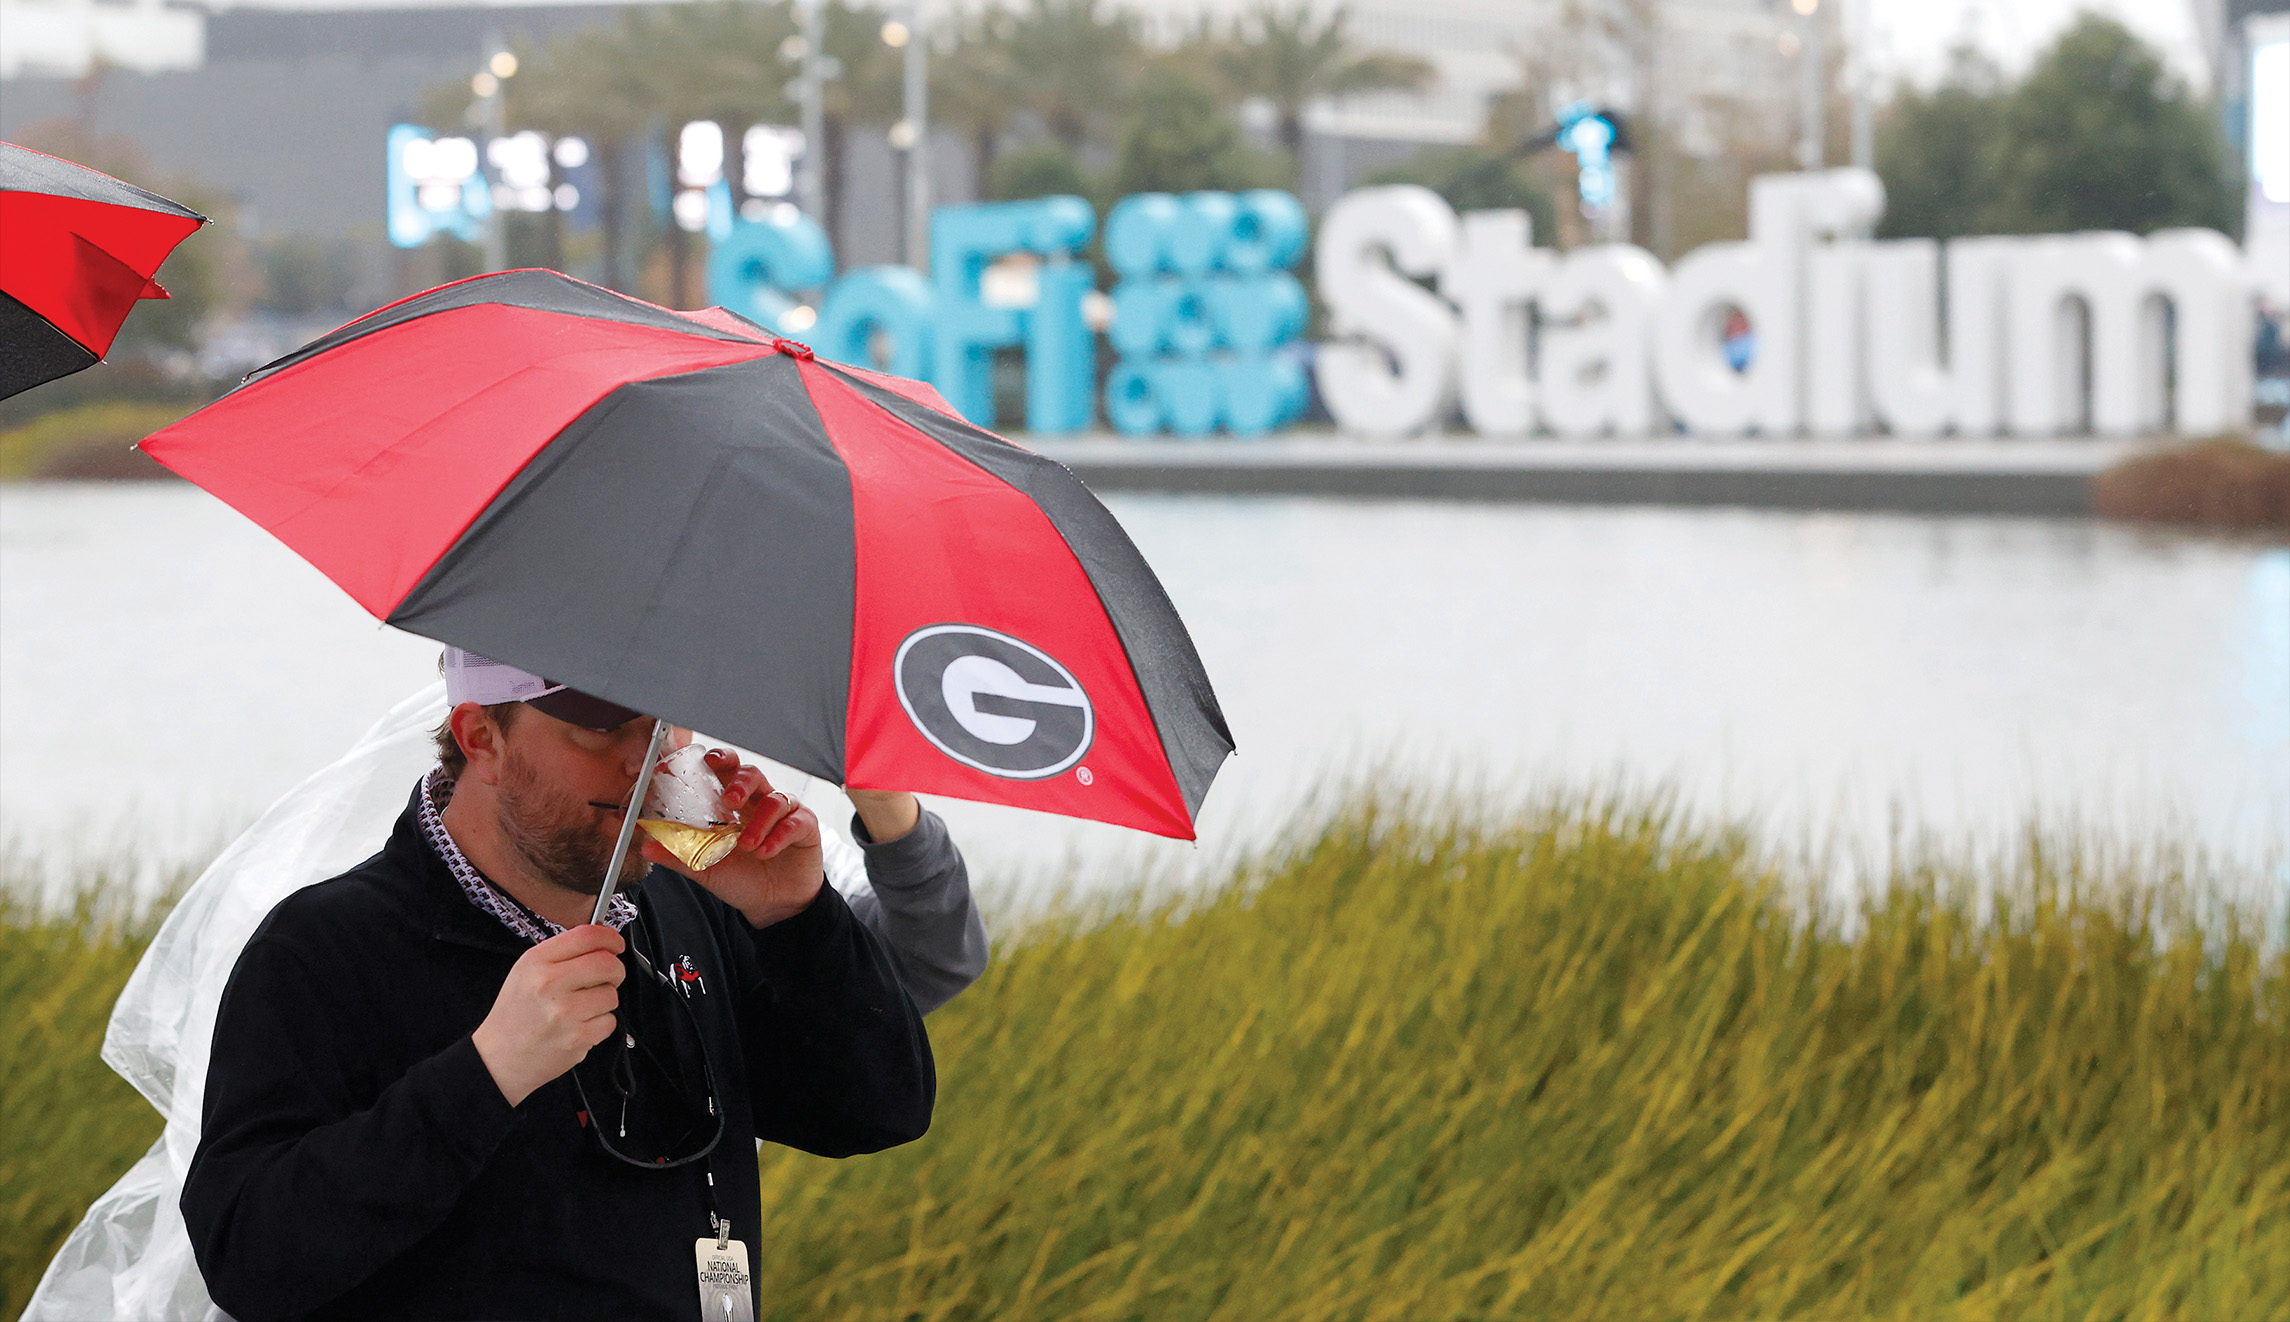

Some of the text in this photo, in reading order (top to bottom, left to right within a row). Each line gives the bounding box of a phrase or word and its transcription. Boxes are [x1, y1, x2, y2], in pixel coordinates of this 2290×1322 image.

[1314, 168, 2250, 438] Stadium
[893, 622, 1096, 782] G
[700, 1271, 749, 1285] CHAMPIONSHIP
[707, 1260, 740, 1273] NATIONAL
